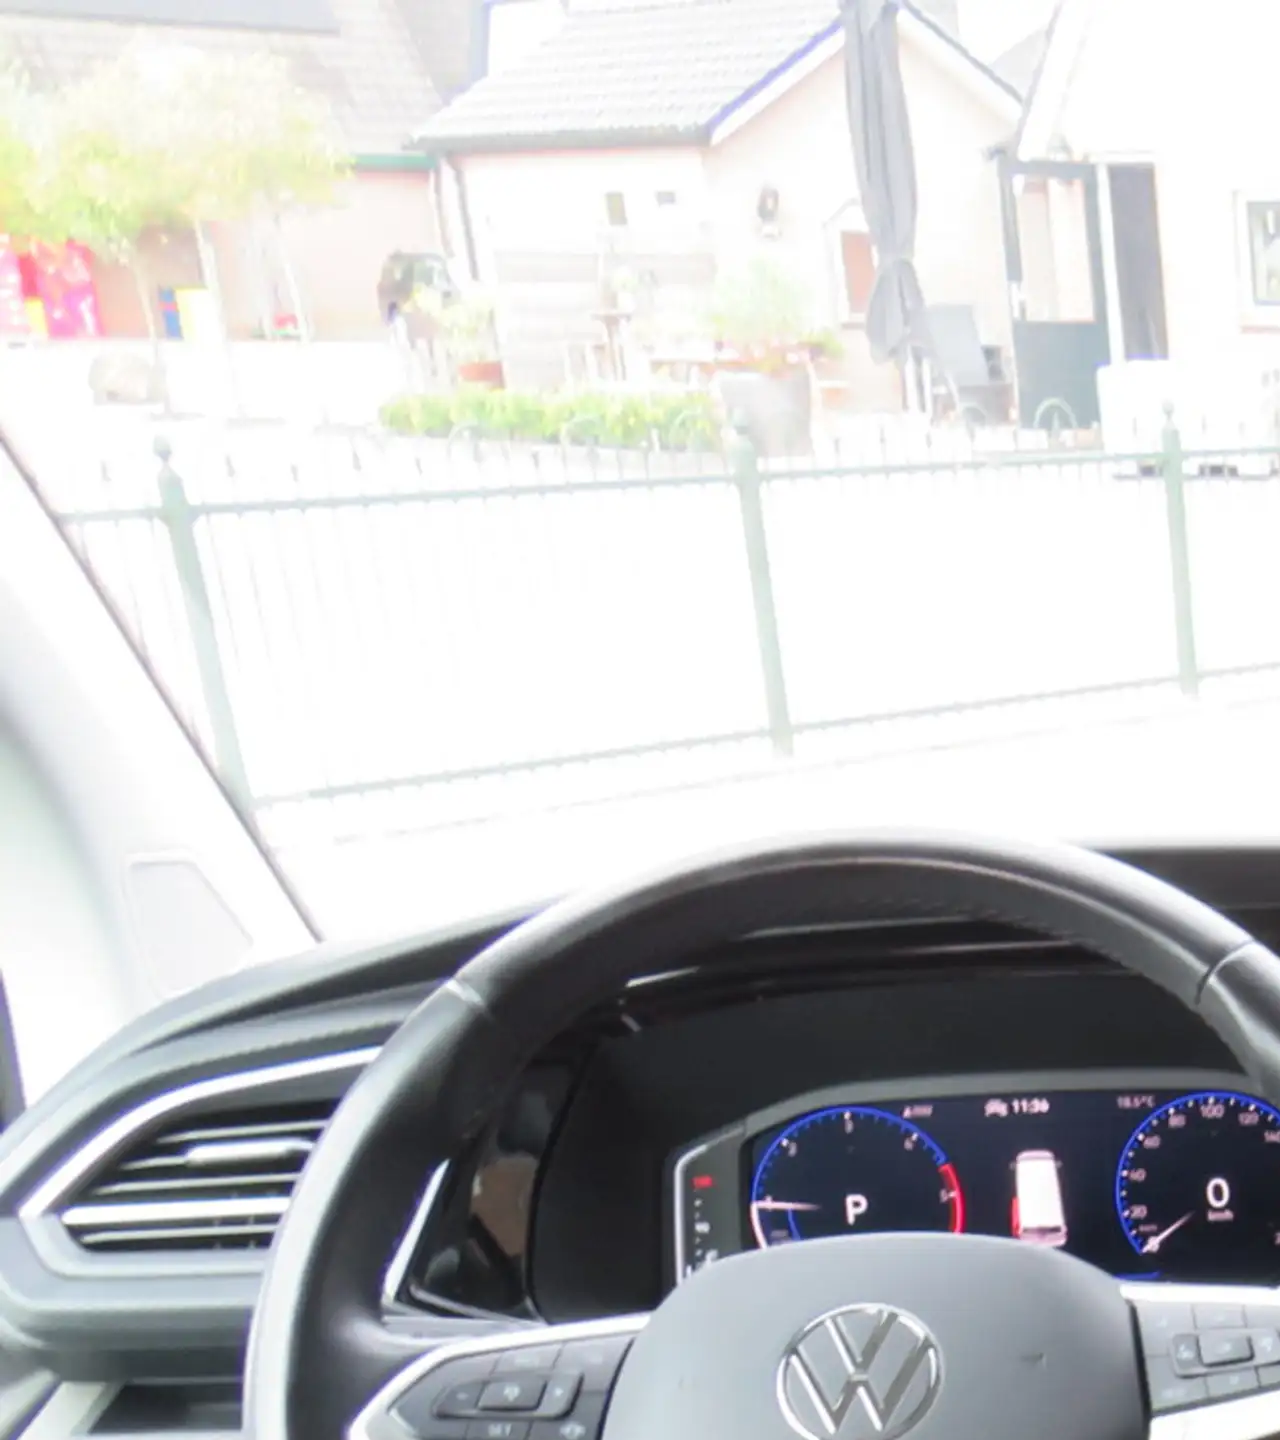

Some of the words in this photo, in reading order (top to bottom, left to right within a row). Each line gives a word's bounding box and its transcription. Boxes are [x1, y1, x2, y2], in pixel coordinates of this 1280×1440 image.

[1200, 1104, 1225, 1119] 100
[1206, 1177, 1230, 1208] 0
[845, 1194, 868, 1226] P
